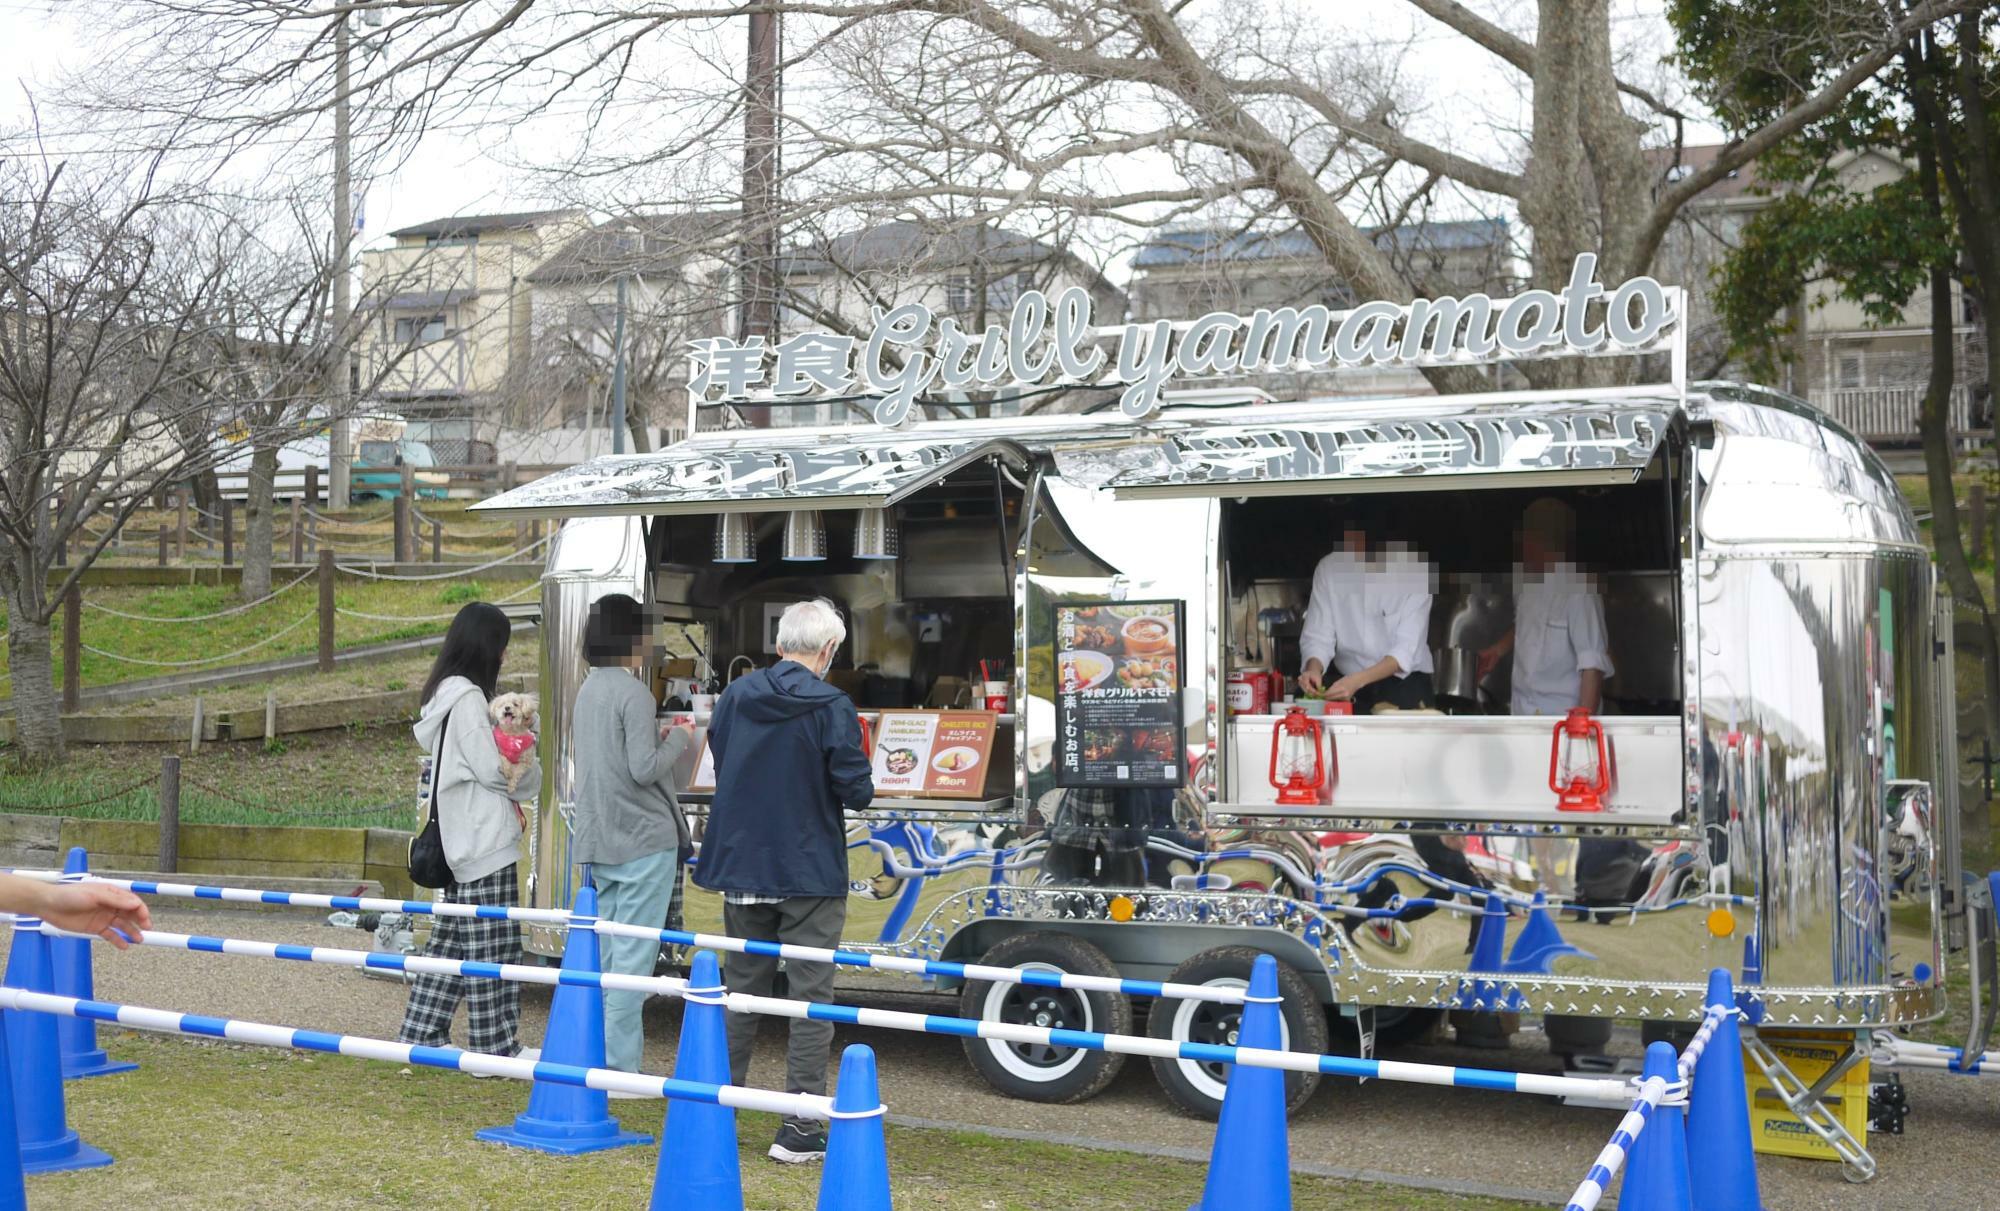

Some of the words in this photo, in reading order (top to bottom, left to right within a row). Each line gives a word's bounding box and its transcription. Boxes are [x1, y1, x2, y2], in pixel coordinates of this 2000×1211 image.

[686, 332, 856, 399] 洋食
[865, 286, 1106, 428] Grill
[1117, 252, 1678, 418] yamamoto
